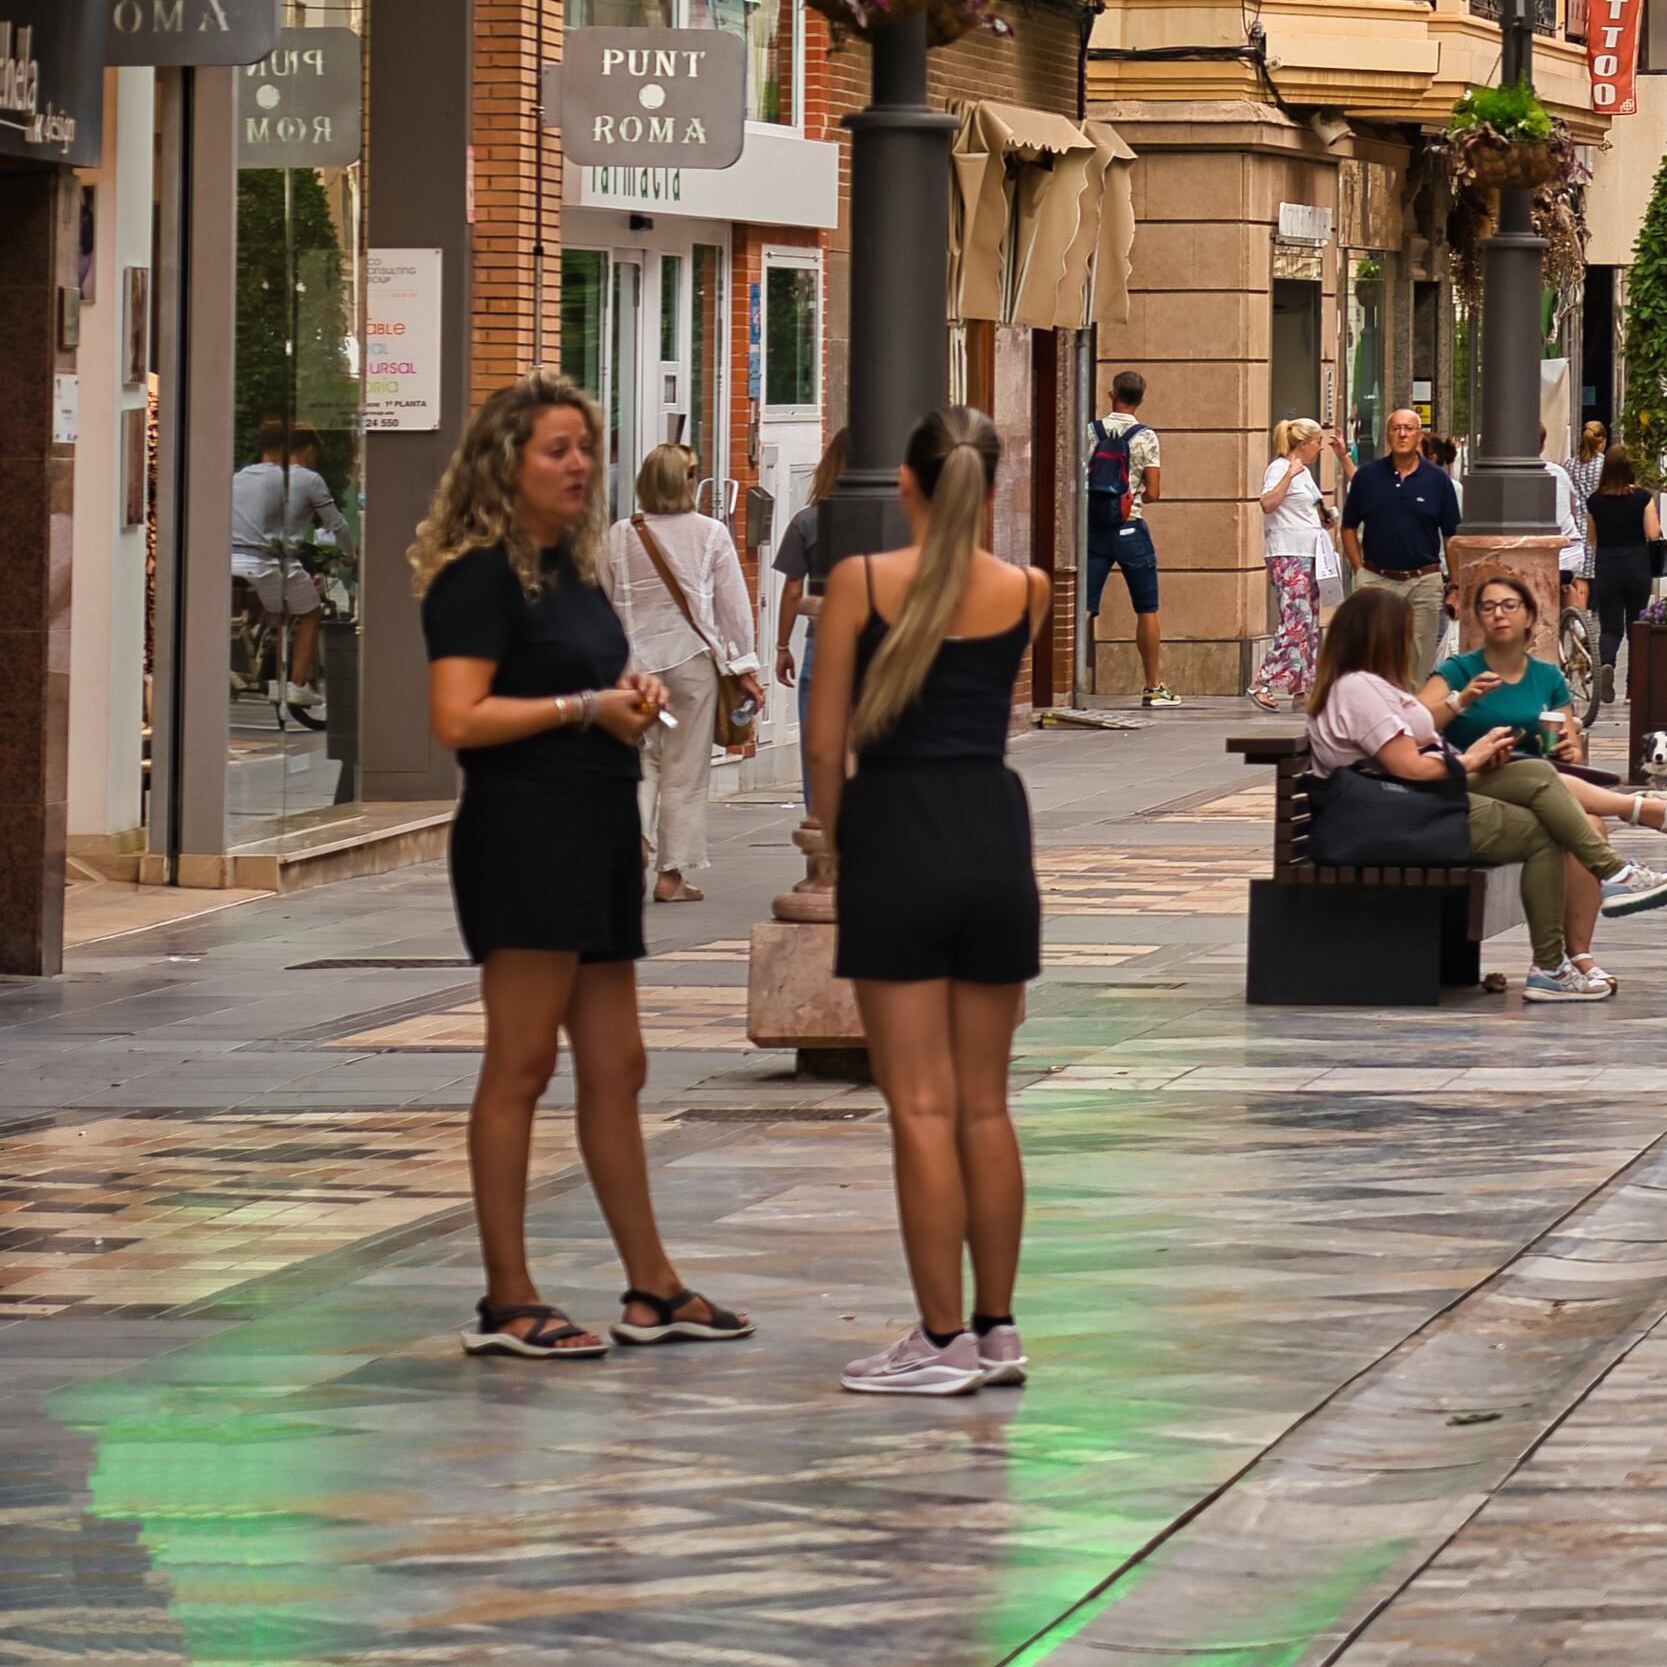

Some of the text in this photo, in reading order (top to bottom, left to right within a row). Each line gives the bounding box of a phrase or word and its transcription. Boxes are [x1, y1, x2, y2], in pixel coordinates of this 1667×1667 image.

[601, 48, 705, 78] PUNT
[592, 114, 708, 145] ROMA
[367, 266, 417, 276] ONSULTING
[394, 400, 427, 408] PLANTA
[381, 419, 399, 427] 550
